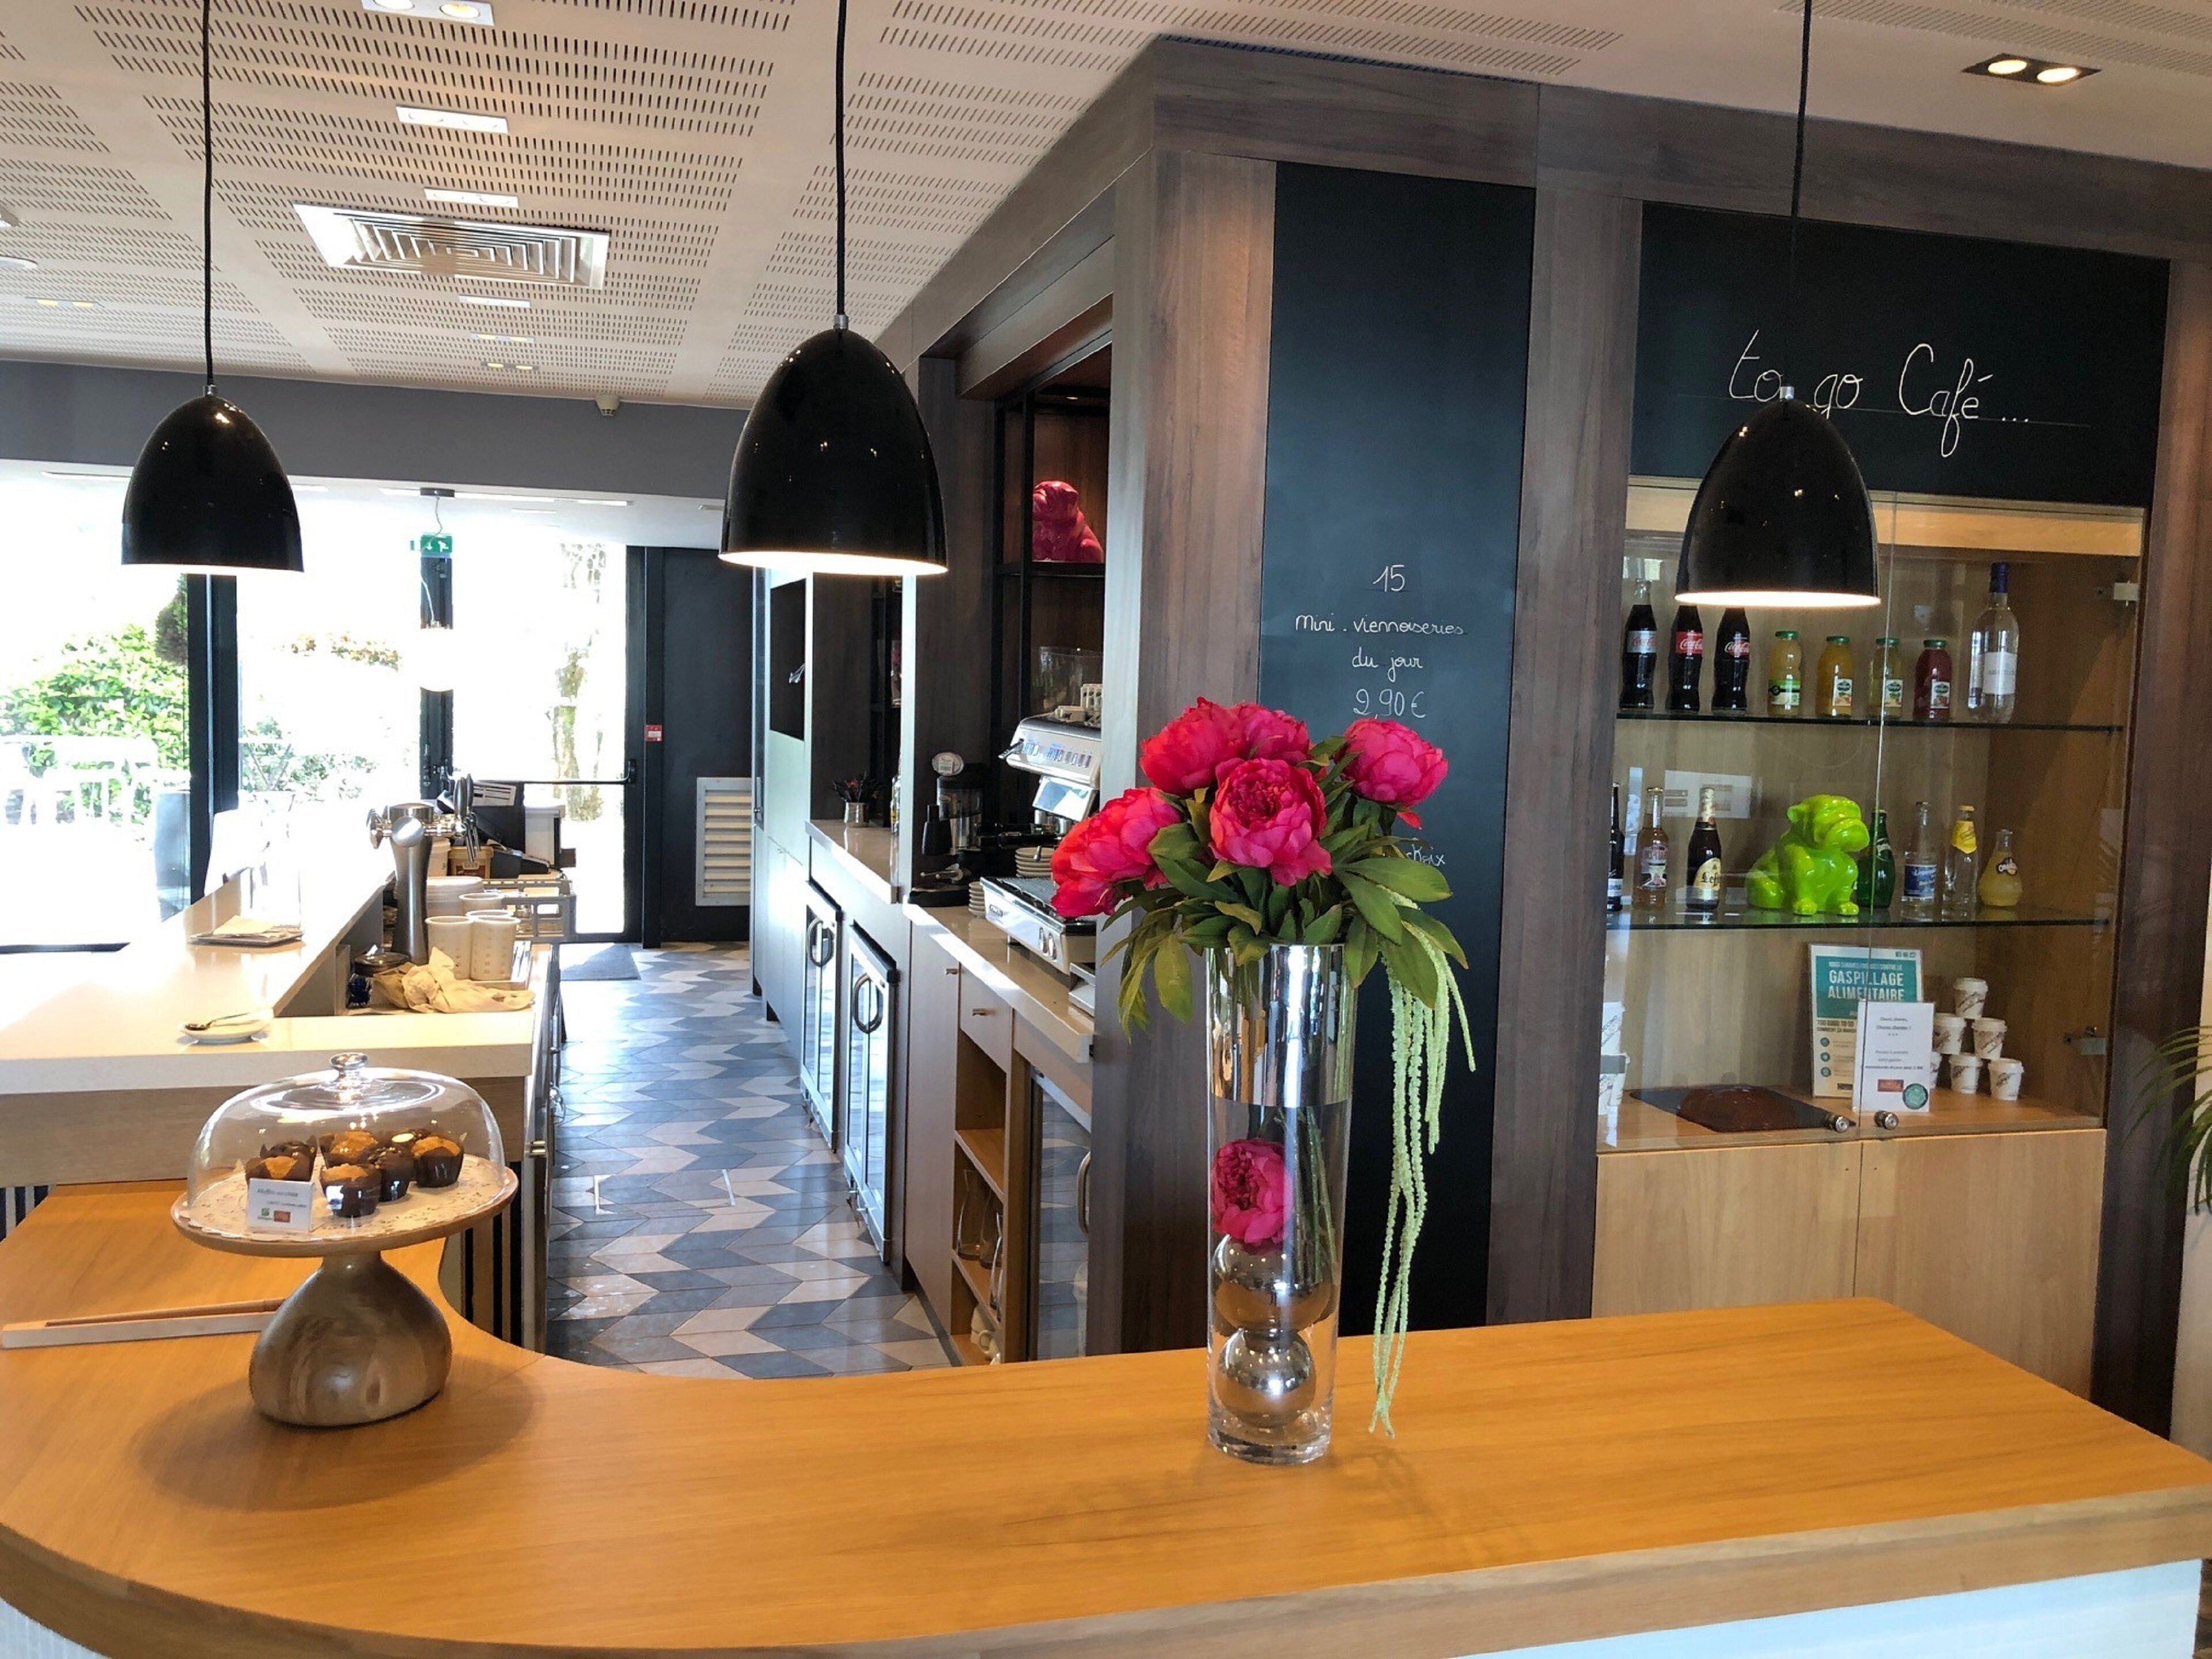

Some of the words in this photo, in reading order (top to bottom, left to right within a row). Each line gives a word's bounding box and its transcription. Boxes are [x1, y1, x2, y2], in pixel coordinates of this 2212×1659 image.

[1729, 329, 1785, 402] to
[1813, 373, 1864, 419] go
[1372, 564, 1406, 593] 15
[1351, 646, 1378, 669] du
[1387, 650, 1424, 683] jour
[1828, 969, 1904, 986] GASPILLAGE
[1828, 985, 1905, 1001] ALIMENTAIRE
